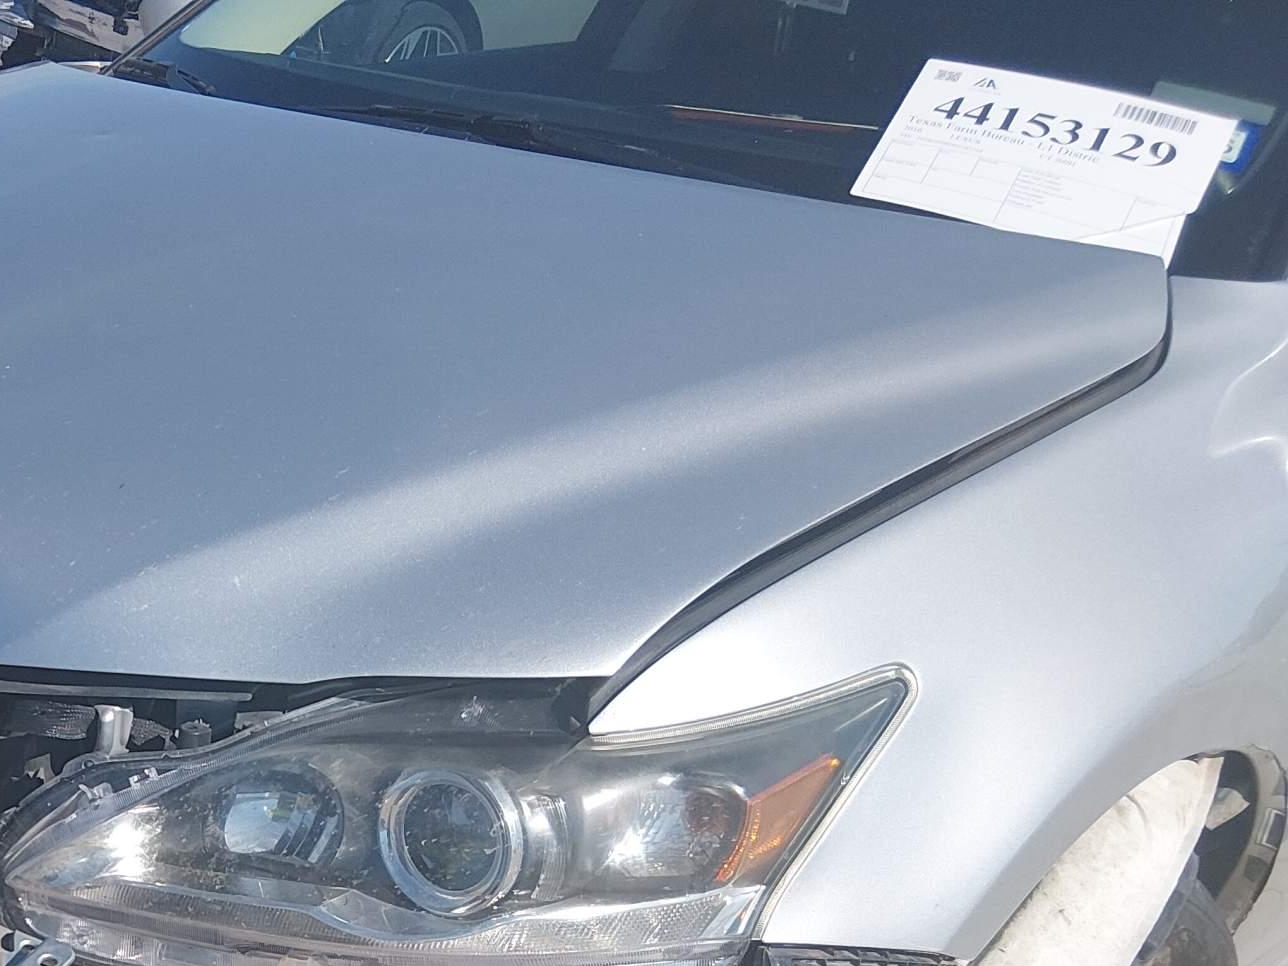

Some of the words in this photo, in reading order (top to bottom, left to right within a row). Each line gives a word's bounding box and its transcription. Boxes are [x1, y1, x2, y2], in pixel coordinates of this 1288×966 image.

[908, 115, 943, 129] Texas
[946, 121, 977, 135] Farm
[981, 129, 1025, 145] Bureau
[933, 96, 1177, 167] 44153129
